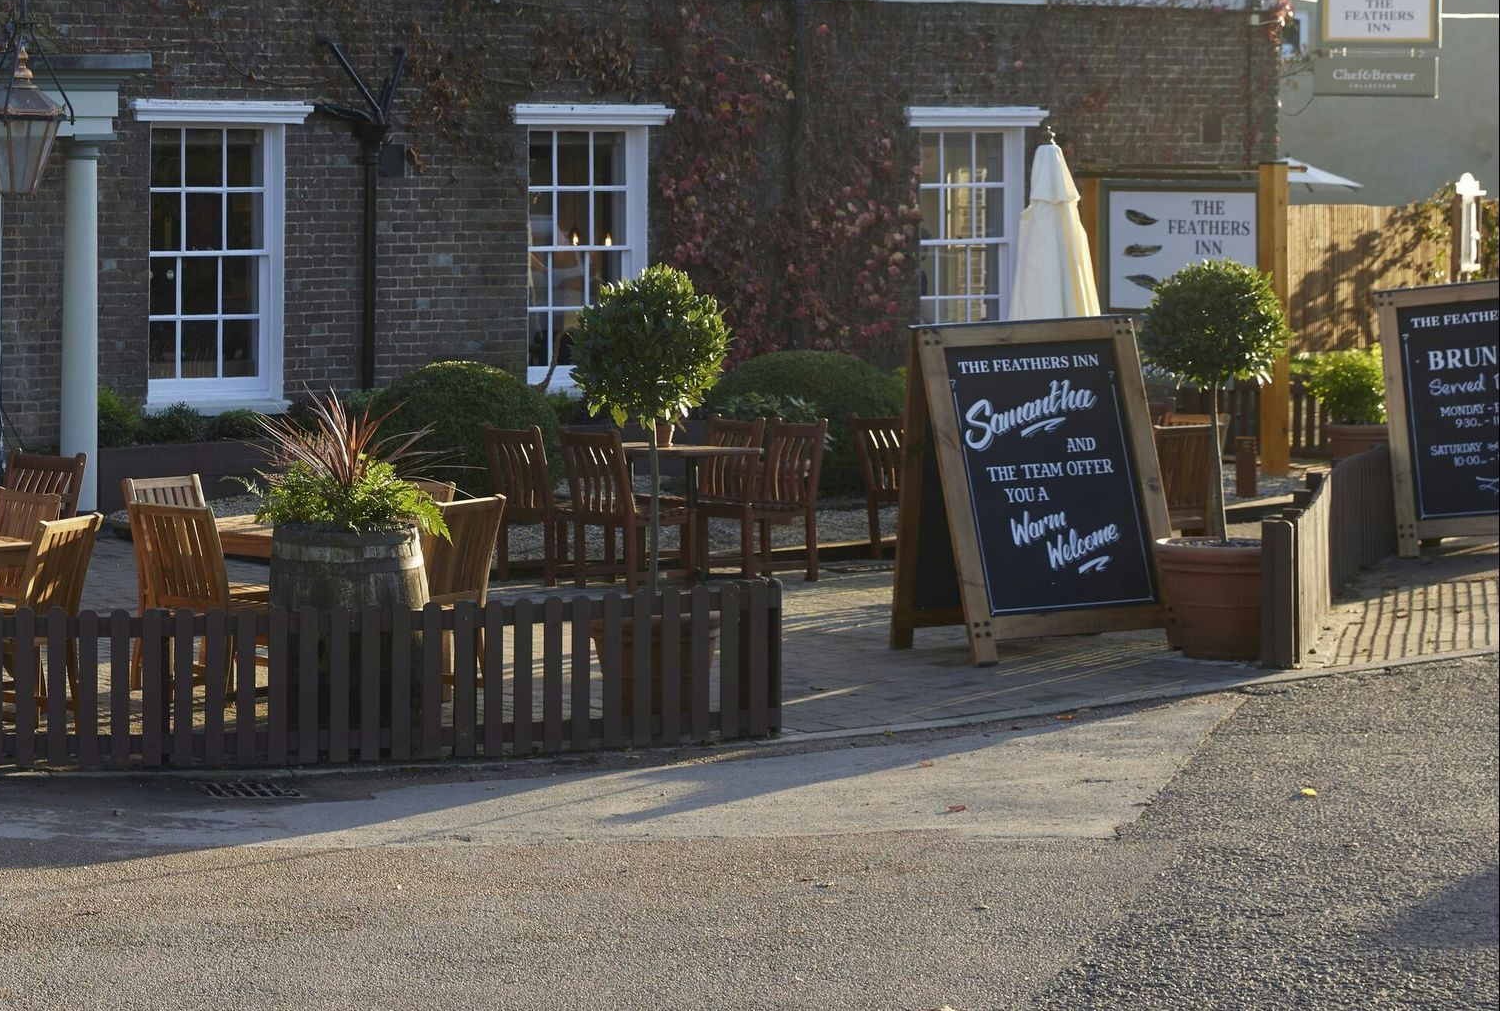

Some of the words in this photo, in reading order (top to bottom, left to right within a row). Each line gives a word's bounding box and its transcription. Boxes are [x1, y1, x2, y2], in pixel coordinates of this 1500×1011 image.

[1344, 10, 1415, 21] FEATHERS
[1367, 22, 1391, 33] INN
[1192, 200, 1225, 216] THE
[1168, 219, 1250, 237] FEATHERS
[1195, 240, 1224, 256] INN
[1411, 316, 1440, 328] THE
[1443, 310, 1499, 325] FEATHE
[957, 360, 989, 374] THE
[993, 356, 1069, 372] FEATHERS
[1073, 354, 1100, 368] INN
[1428, 346, 1497, 370] BRUN
[1429, 373, 1485, 396] Served
[964, 379, 1097, 452] Samantha
[1440, 404, 1485, 417] MONDAY
[1067, 437, 1096, 453] AND
[1430, 442, 1483, 456] SATURDAY
[986, 465, 1018, 482] THE
[1021, 462, 1063, 479] TEAM
[1067, 458, 1114, 476] OFFER
[1004, 487, 1035, 503] YOU
[1037, 487, 1050, 501] A
[1010, 510, 1067, 547] Warm
[1047, 523, 1120, 570] Welcome
